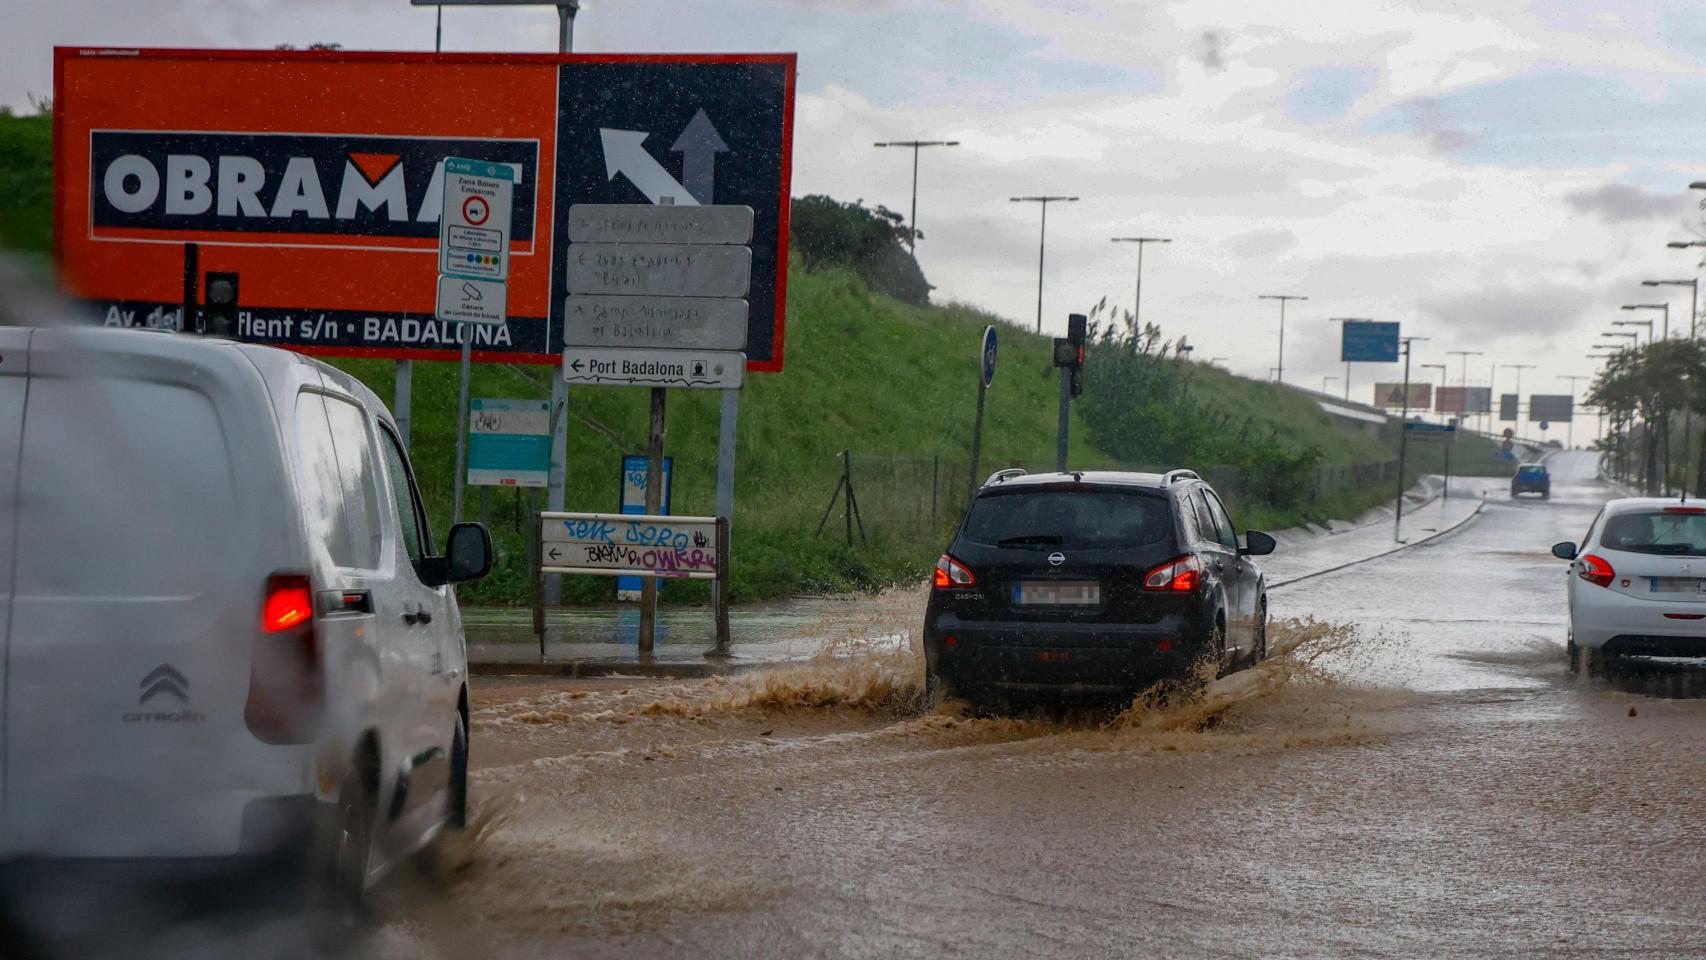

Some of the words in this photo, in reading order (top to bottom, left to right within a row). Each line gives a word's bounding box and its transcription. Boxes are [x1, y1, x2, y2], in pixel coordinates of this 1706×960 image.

[104, 154, 523, 223] OBRAM
[300, 314, 338, 340] s/n
[363, 317, 512, 346] BADALONA
[589, 359, 616, 374] Port
[622, 360, 684, 376] Badalona
